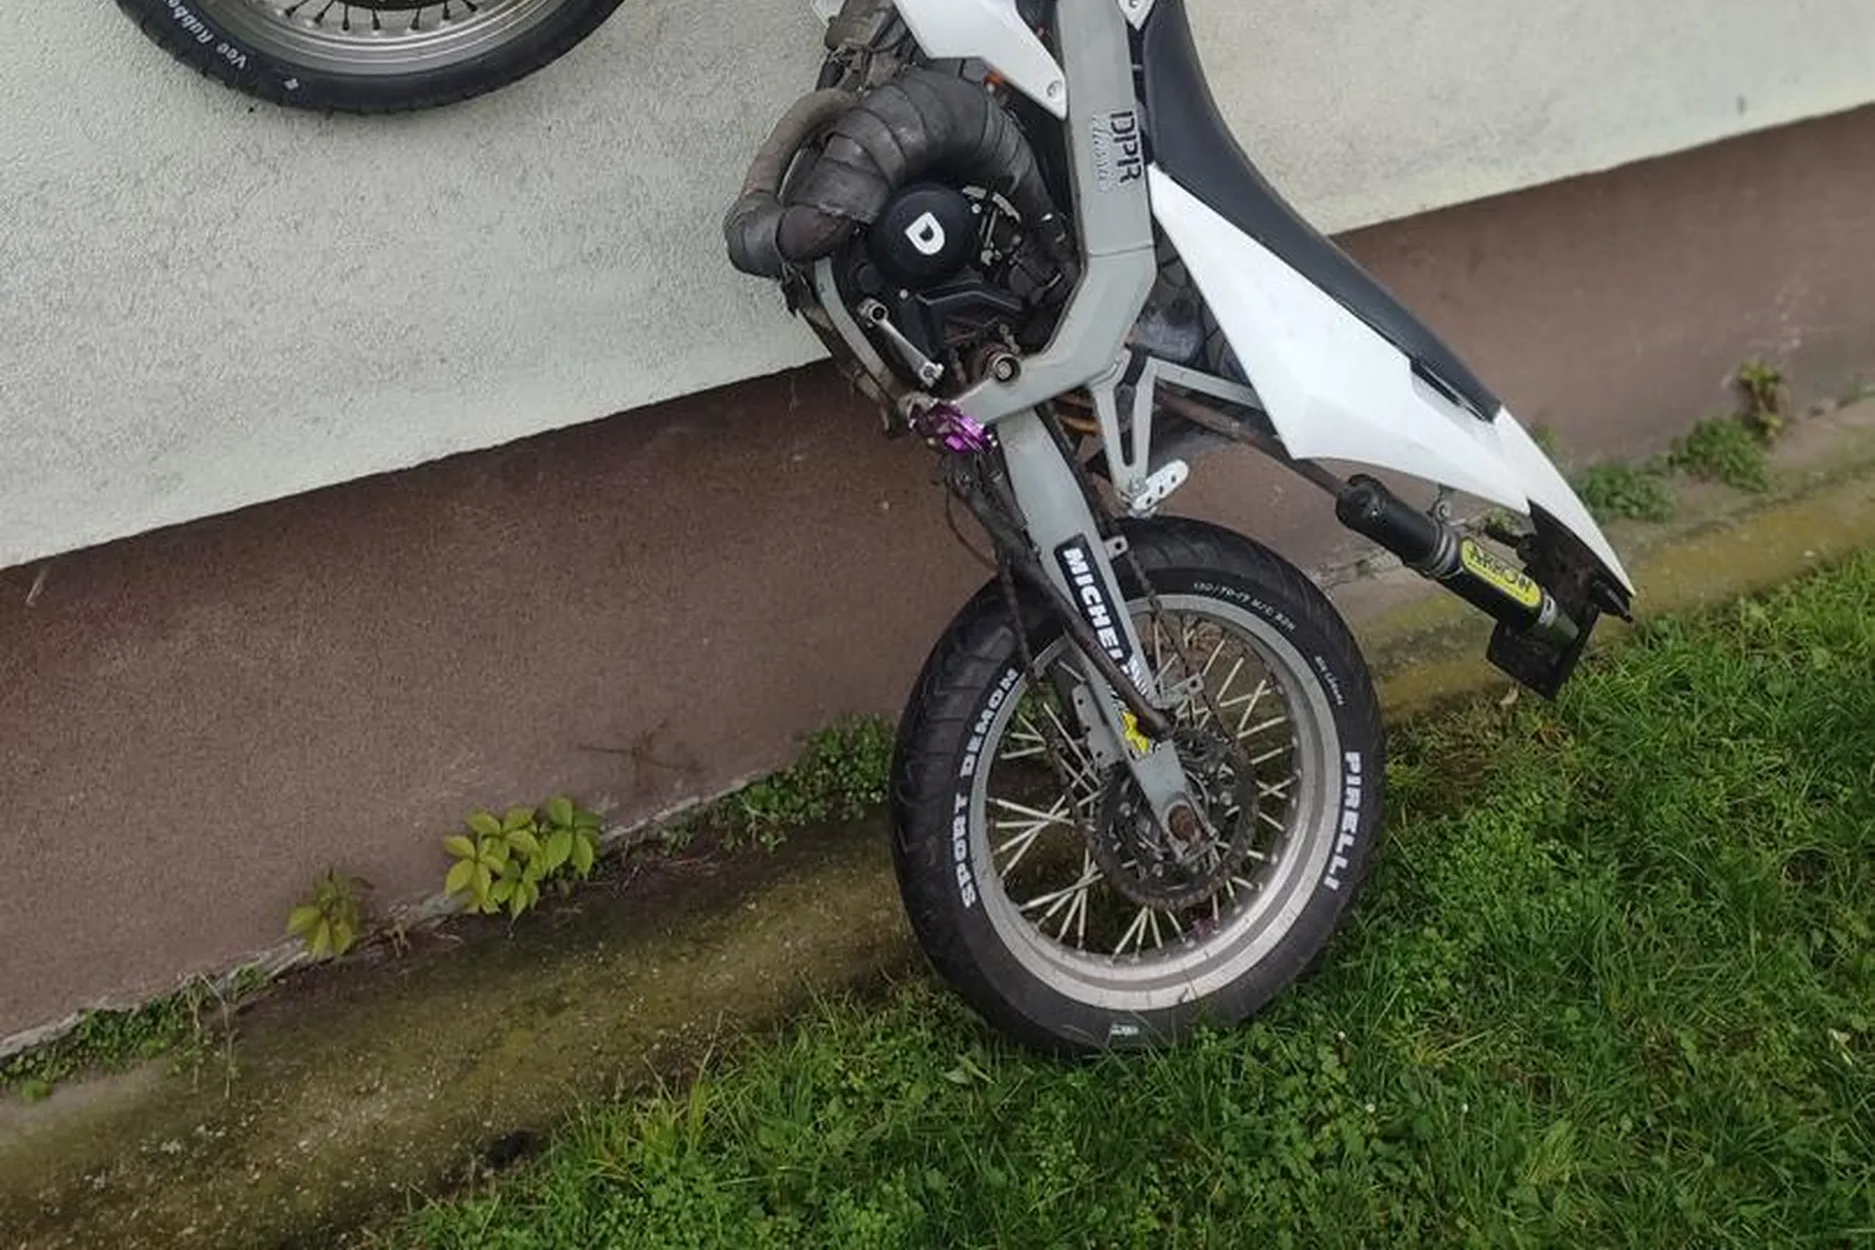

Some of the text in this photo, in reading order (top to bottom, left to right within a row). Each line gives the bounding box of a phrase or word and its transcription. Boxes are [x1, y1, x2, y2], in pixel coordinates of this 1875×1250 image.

[216, 41, 248, 69] Vee
[1110, 110, 1142, 184] DPR
[1063, 547, 1130, 675] MICHEL
[952, 667, 1019, 909] SPORT DEMON
[1323, 751, 1361, 891] PIRELLI
